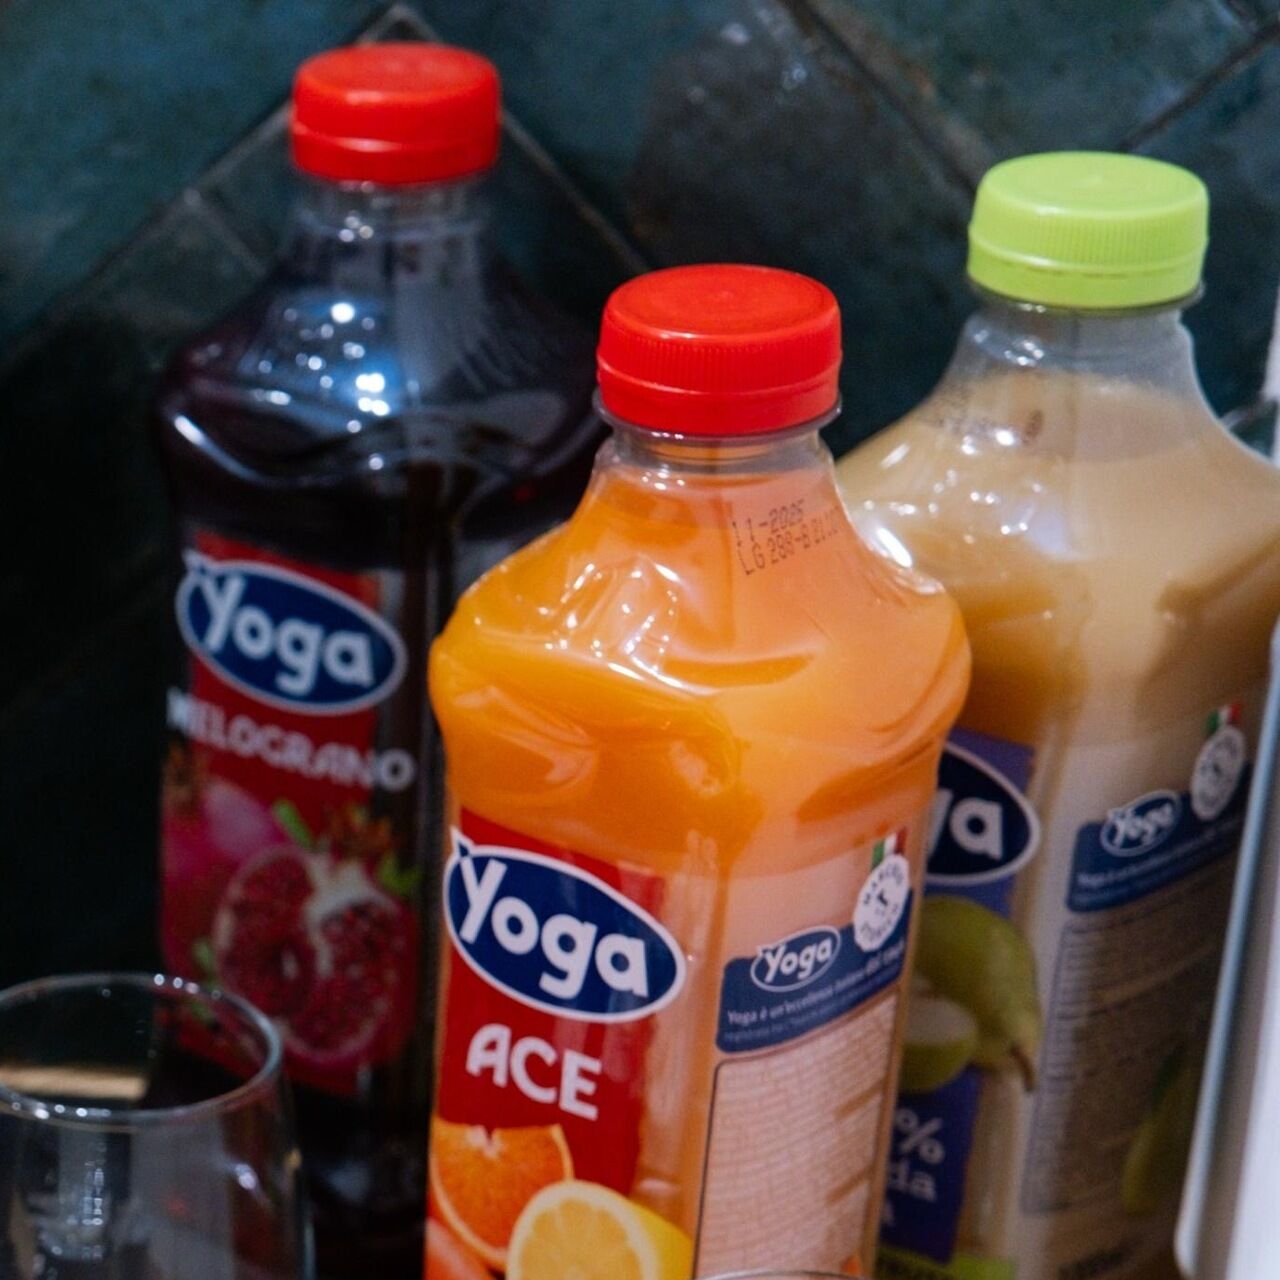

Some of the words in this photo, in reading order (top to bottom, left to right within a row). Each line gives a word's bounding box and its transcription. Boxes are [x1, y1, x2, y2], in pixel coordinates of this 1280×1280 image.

[192, 565, 376, 698] Yoga
[167, 686, 417, 792] MELOGRANO
[456, 852, 650, 999] Yoga
[763, 937, 833, 984] Yoga
[464, 1022, 603, 1123] ACE
